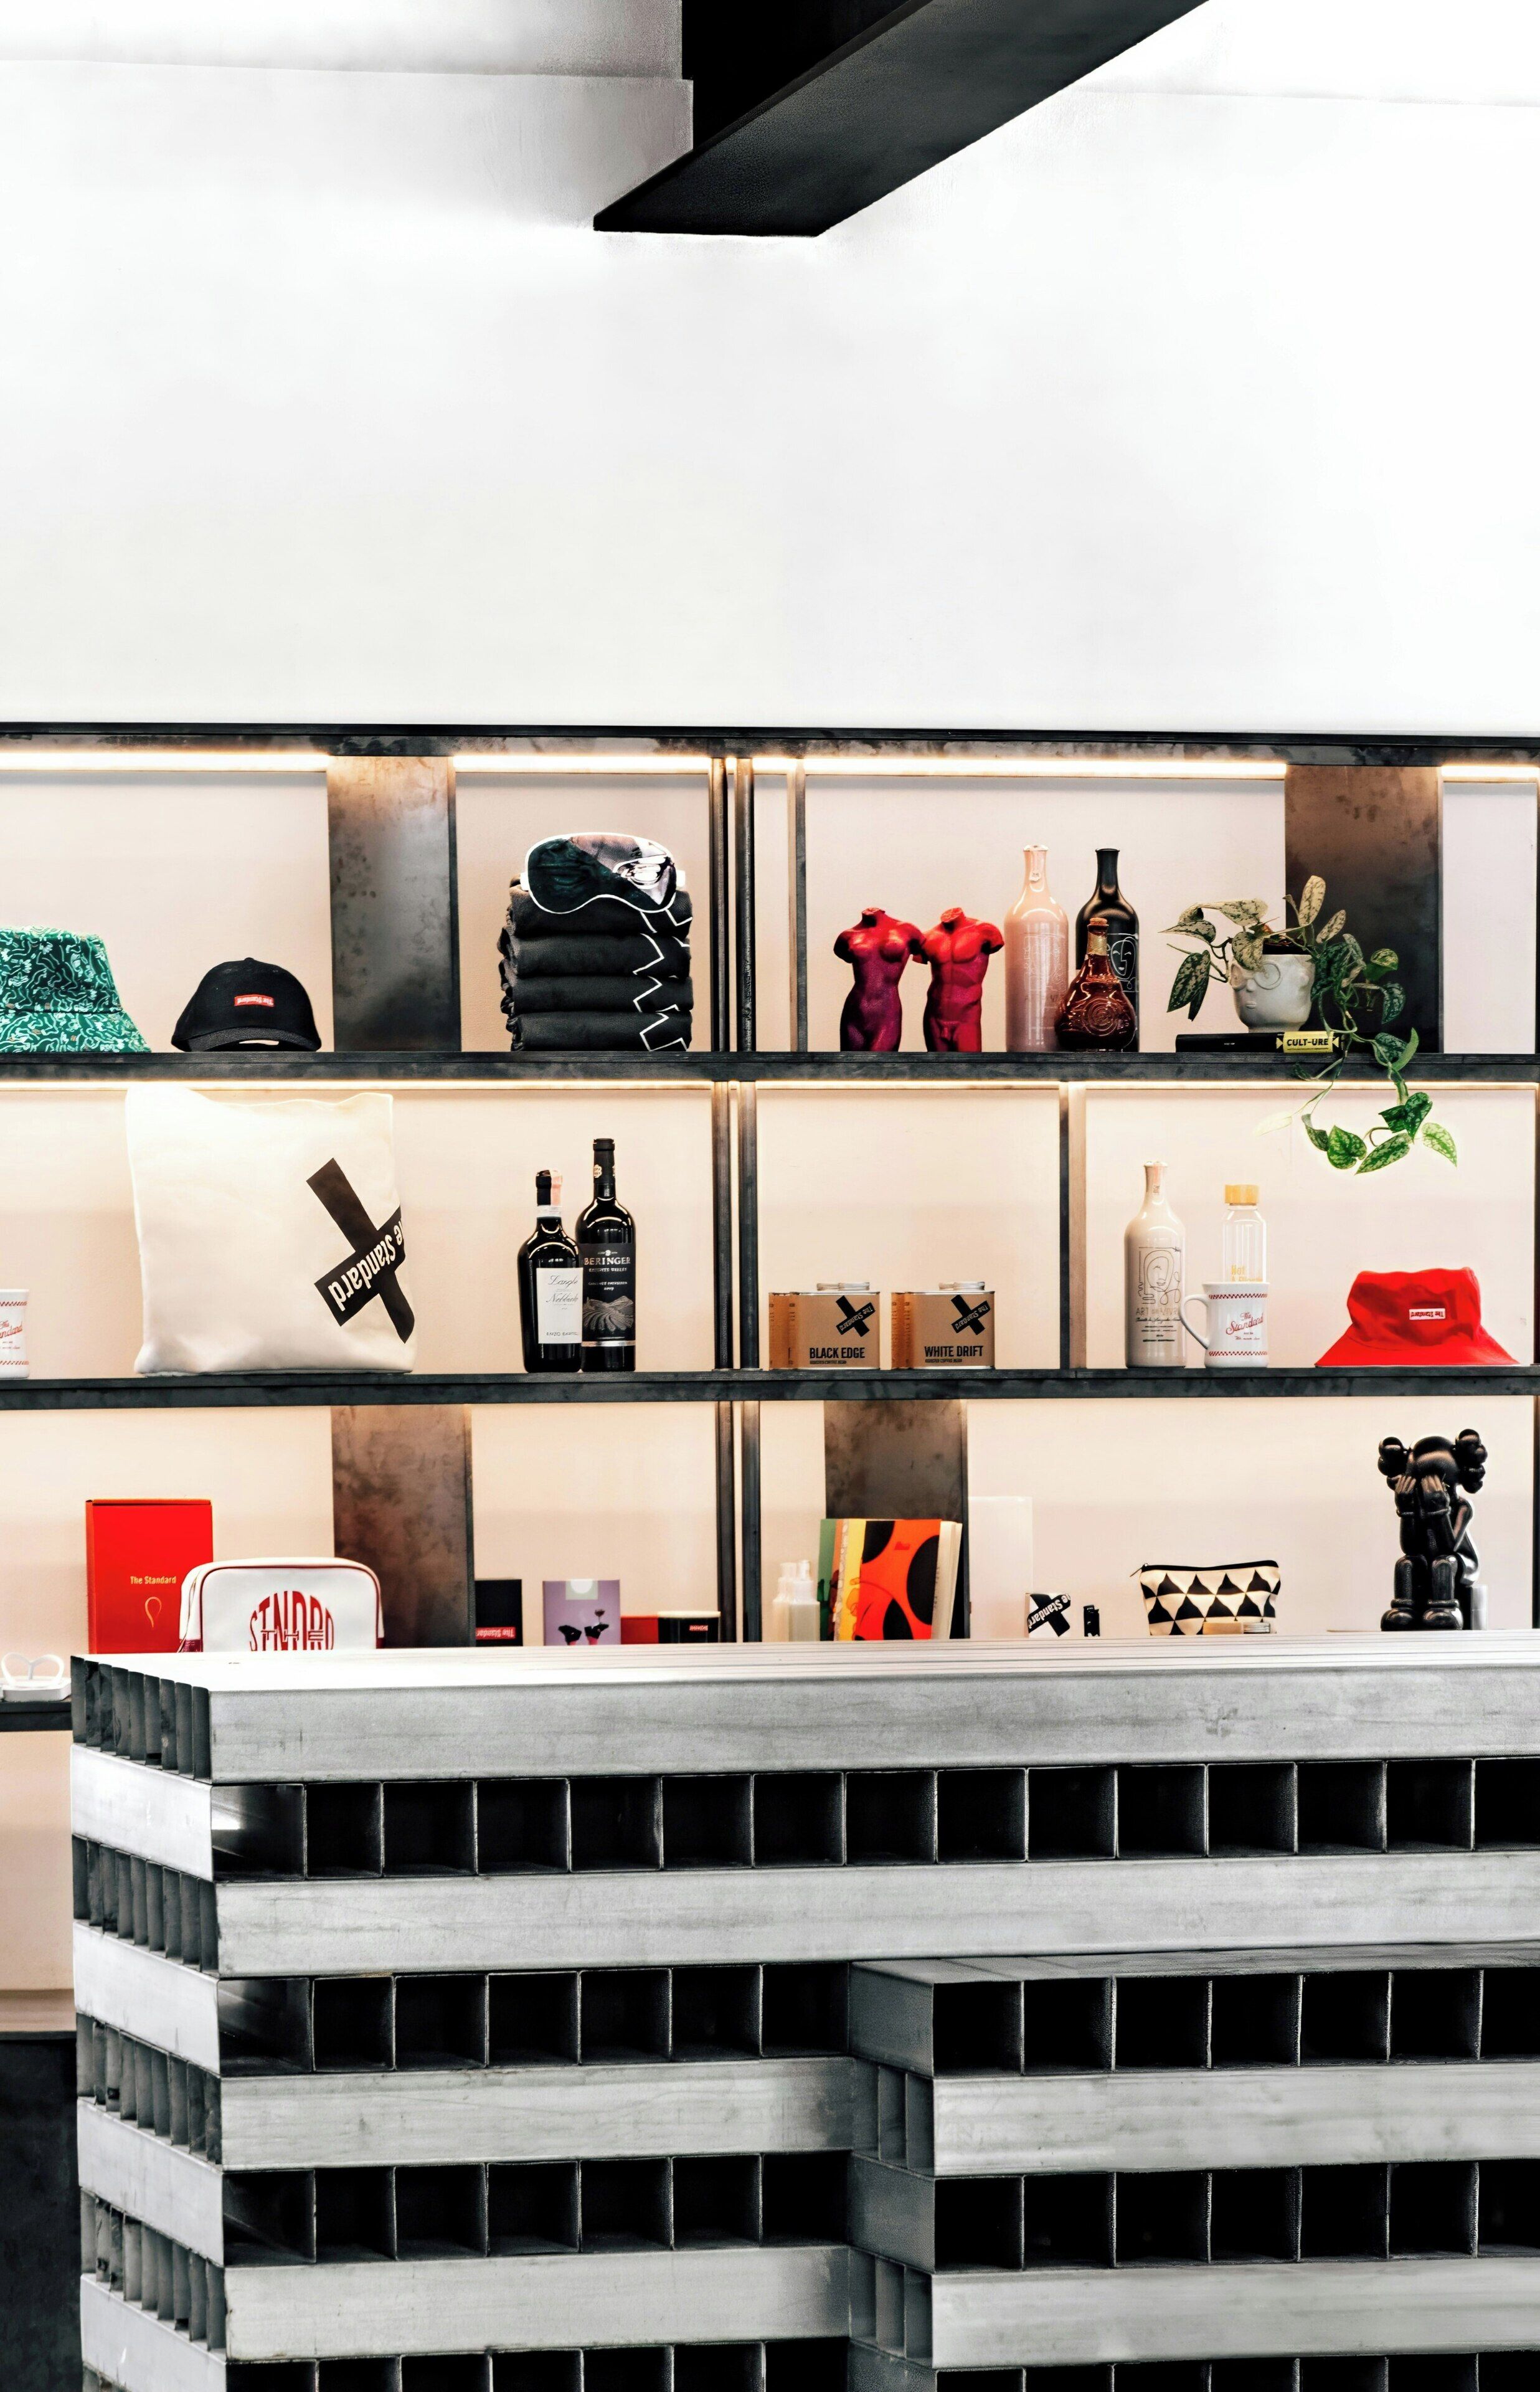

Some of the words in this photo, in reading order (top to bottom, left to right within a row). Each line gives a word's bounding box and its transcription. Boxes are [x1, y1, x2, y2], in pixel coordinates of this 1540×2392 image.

[1287, 1038, 1329, 1046] CULT-URE
[583, 1257, 631, 1266] BERINGER
[328, 1234, 397, 1312] Standard
[1226, 1312, 1264, 1335] Standard
[810, 1347, 839, 1359] BLACK
[841, 1347, 866, 1359] EDGE
[925, 1346, 954, 1357] WHITE
[957, 1345, 984, 1357] DRIFT
[130, 1575, 143, 1585] The
[144, 1575, 177, 1585] Standard
[476, 1628, 501, 1638] Standar
